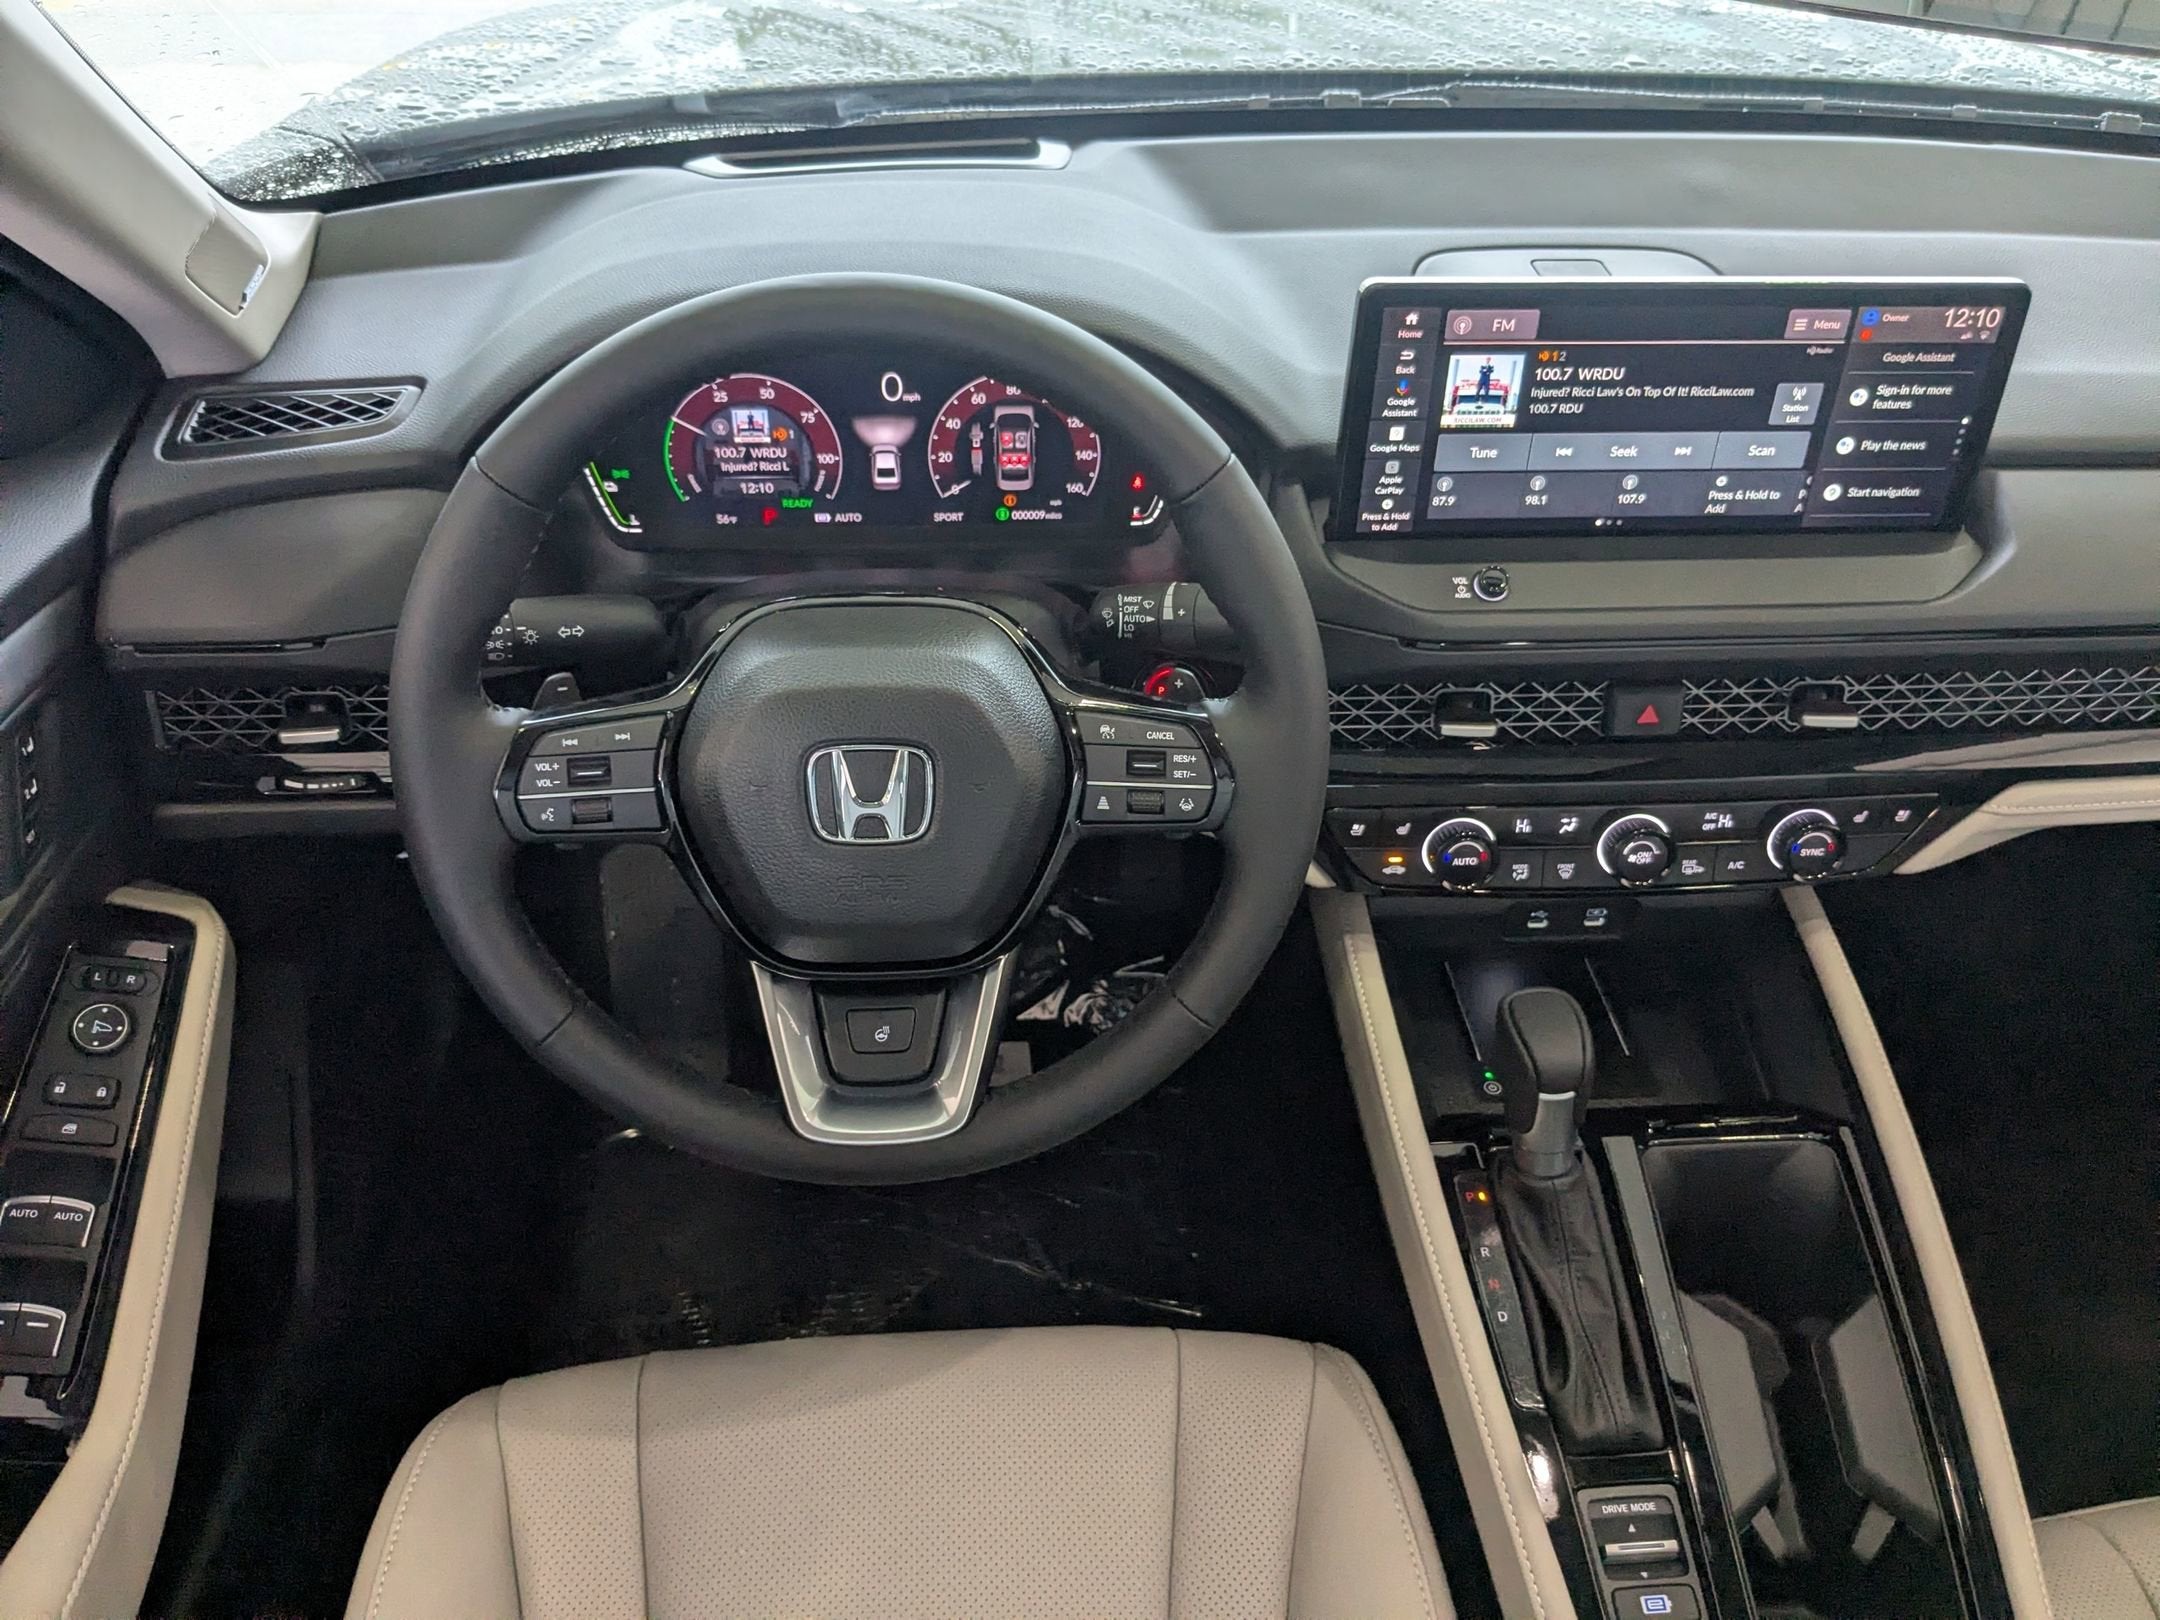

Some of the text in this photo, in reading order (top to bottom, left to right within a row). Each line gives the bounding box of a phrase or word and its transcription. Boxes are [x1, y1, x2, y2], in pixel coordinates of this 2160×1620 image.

[1882, 314, 1909, 322] Owner
[1945, 308, 2001, 328] 12:10
[1492, 319, 1516, 332] FM
[1813, 320, 1840, 330] Menu
[1398, 330, 1423, 338] Home
[1559, 352, 1566, 361] 2
[1883, 353, 1955, 363] Google Assistant
[1395, 366, 1415, 374] Back
[1535, 367, 1625, 381] 100.7 WRDU
[881, 372, 921, 403] 0 mph
[1876, 385, 1952, 395] Sign-in for more
[713, 392, 728, 403] 25
[759, 388, 775, 400] 50
[1531, 387, 1754, 399] Injured? Ricci Law's On Top Of It! RicciLaw.com
[971, 393, 986, 405] 60
[1387, 397, 1415, 407] Google
[1528, 404, 1583, 414] 100.7 RDU
[1782, 404, 1809, 412] Station
[1872, 400, 1912, 409] features
[801, 412, 815, 423] 75
[1382, 409, 1417, 417] Assistant
[945, 418, 961, 429] 40
[1370, 444, 1420, 453] Google Maps
[1748, 446, 1776, 456] Scan
[1860, 440, 1926, 452] Play the news
[714, 448, 787, 458] 100.7 WRDU
[1075, 451, 1093, 460] 140
[1470, 448, 1498, 458] Tune
[1610, 446, 1638, 457] Seek
[817, 453, 834, 464] 100
[938, 452, 953, 463] 20
[720, 462, 758, 473] Injured?
[759, 462, 781, 471] Ricci
[1379, 476, 1402, 486] Apple
[740, 482, 774, 494] 12:10
[1066, 483, 1083, 493] 160
[1375, 487, 1404, 496] CarPlay
[1847, 488, 1920, 498] Start navigation
[1617, 494, 1645, 504] 107.9
[1708, 490, 1780, 500] Press & Hold to
[781, 499, 814, 509] READY
[1432, 496, 1455, 507] 87.9
[1525, 495, 1548, 506] 98.1
[1705, 504, 1726, 514] Add
[763, 507, 778, 525] P
[834, 513, 862, 522] AUTO
[933, 512, 964, 523] SPORT
[1011, 510, 1046, 520] 000009
[1362, 513, 1382, 521] Press
[1391, 512, 1410, 520] Hold
[1381, 523, 1398, 531] Add
[1451, 576, 1468, 584] VOL
[1124, 615, 1146, 623] AUTO
[1146, 731, 1174, 740] CANCEL
[1173, 754, 1197, 763] RES/+
[1704, 812, 1718, 820] A/C
[1800, 848, 1824, 856] SYNC
[1452, 858, 1478, 866] AUTO
[1728, 861, 1745, 869] A/C
[94, 972, 101, 981] L
[126, 974, 136, 984] R
[1466, 1192, 1474, 1201] P
[9, 1208, 38, 1218] AUTO
[54, 1211, 84, 1222] AUTO
[1480, 1247, 1490, 1257] R
[1498, 1312, 1508, 1322] D
[1602, 1502, 1656, 1513] DRIVE MODE
